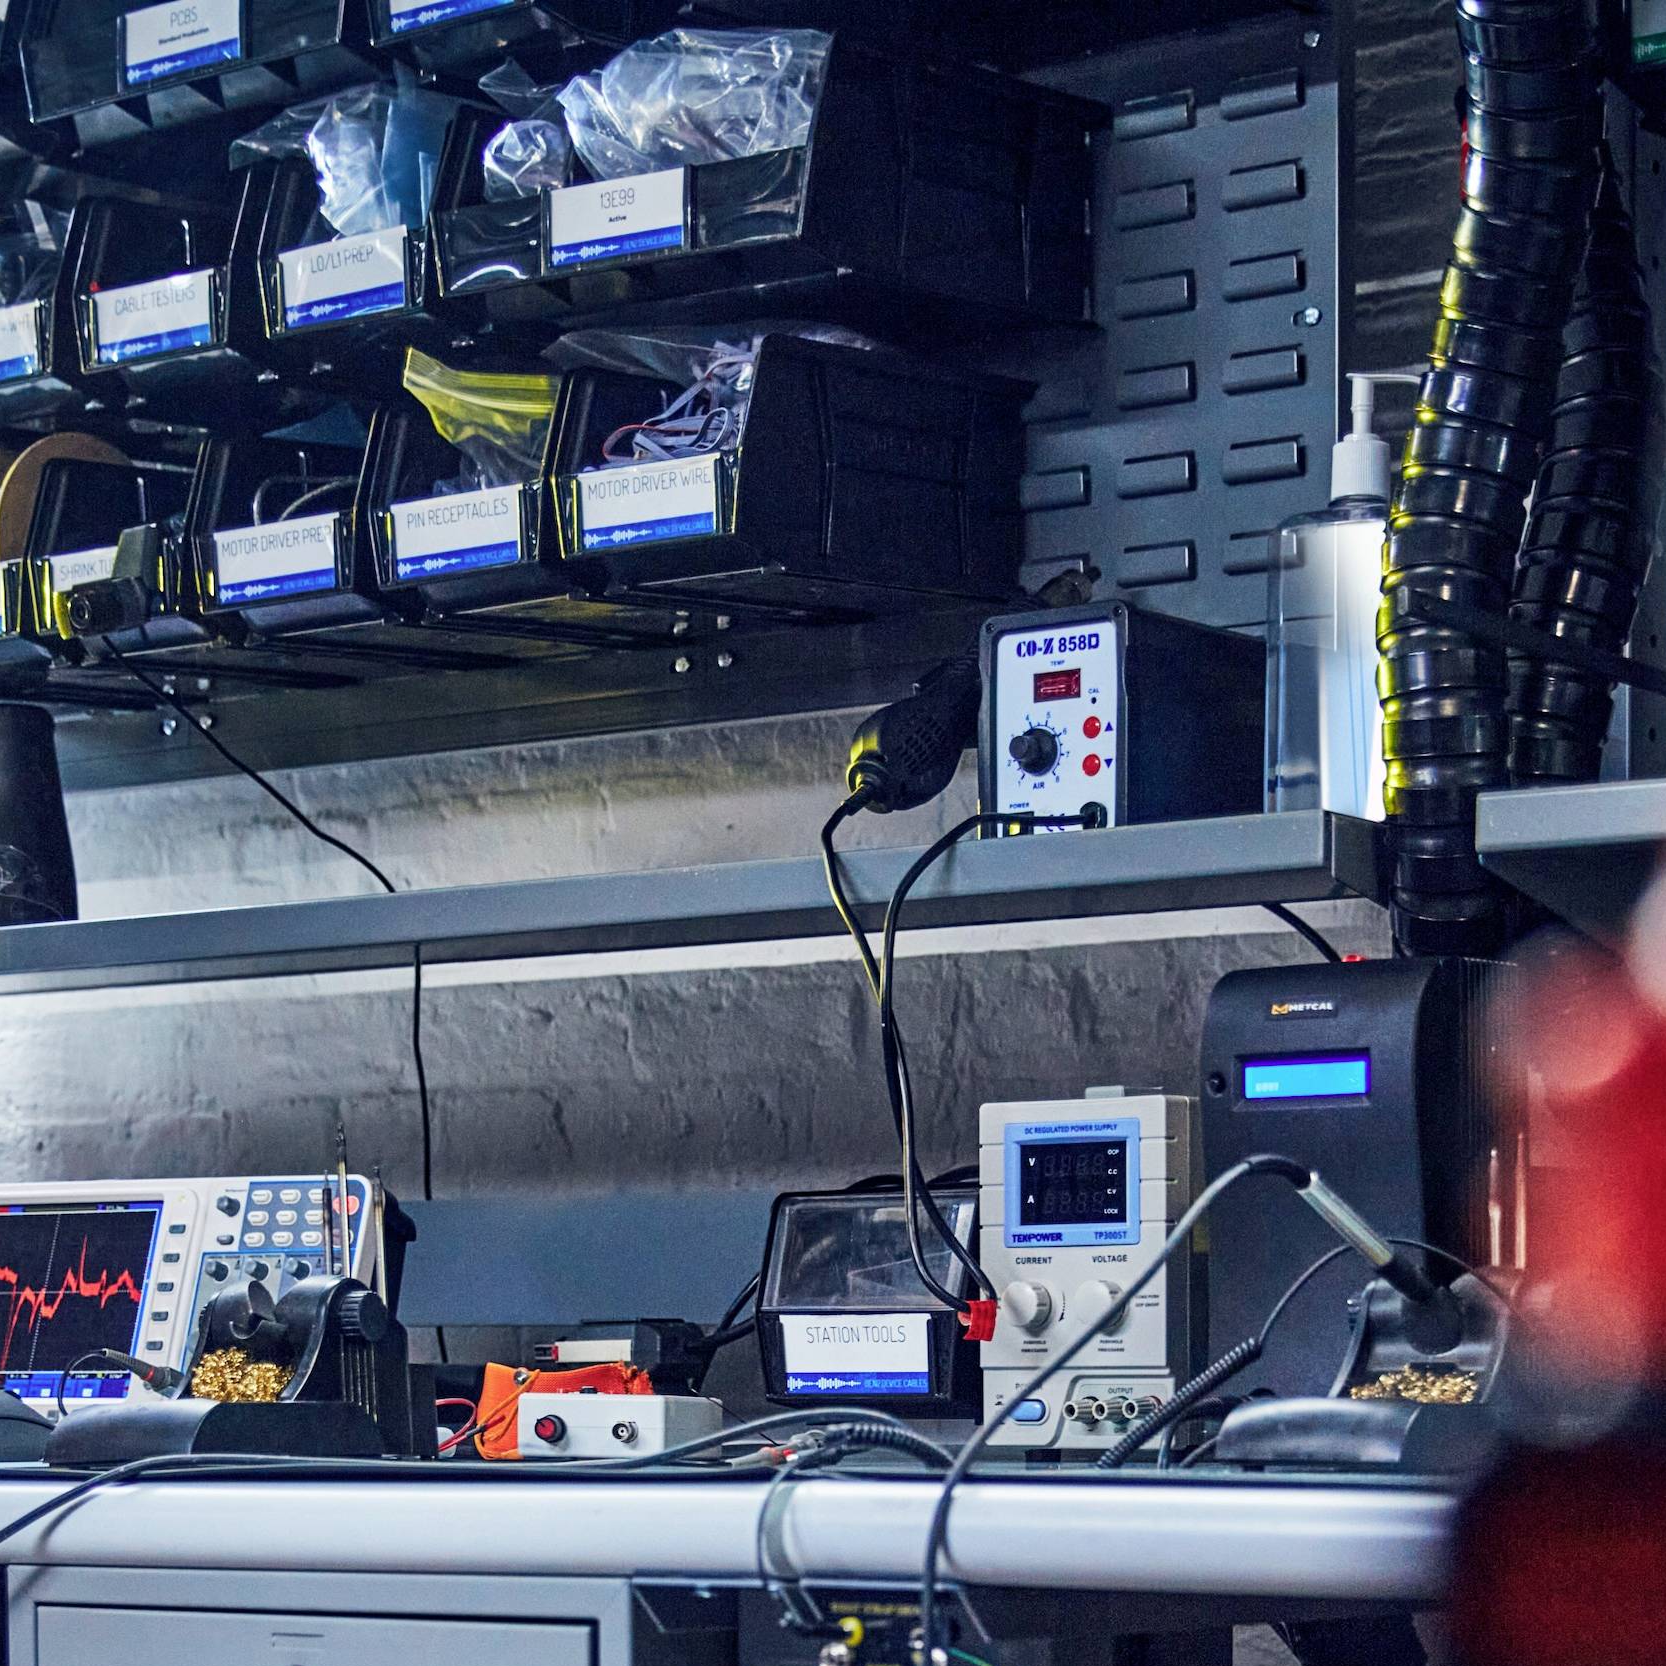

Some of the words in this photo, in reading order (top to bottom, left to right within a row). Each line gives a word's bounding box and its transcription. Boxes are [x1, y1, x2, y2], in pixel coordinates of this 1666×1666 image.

[169, 8, 198, 28] PCBS
[599, 187, 636, 210] 13E99
[607, 213, 628, 225] Active
[343, 246, 375, 269] PREP
[114, 295, 150, 317] CABLE
[149, 286, 196, 312] TESTERS
[588, 479, 630, 501] MOTOR
[633, 472, 677, 495] DRIVER
[679, 466, 711, 488] WIRE
[407, 510, 426, 528] PIN
[427, 498, 509, 526] RECEPTACLES
[221, 538, 259, 557] MOTOR
[260, 530, 300, 552] DRIVER
[302, 524, 333, 545] PREP
[59, 561, 97, 581] SHRINK
[1016, 637, 1055, 658] CO-Z
[1058, 633, 1100, 653] 858D
[1033, 782, 1045, 790] AIR
[1288, 1002, 1334, 1012] METCAL
[1025, 1127, 1033, 1135] DC
[1034, 1125, 1070, 1134] REGULATED
[1070, 1123, 1093, 1133] POWER
[1094, 1123, 1117, 1132] SUPPLY
[1028, 1157, 1036, 1166] V
[1027, 1194, 1035, 1204] A
[1015, 1256, 1052, 1265] CURRENT
[1092, 1254, 1128, 1263] VOLTAGE
[806, 1326, 861, 1344] STATION
[863, 1325, 907, 1343] TOOLS
